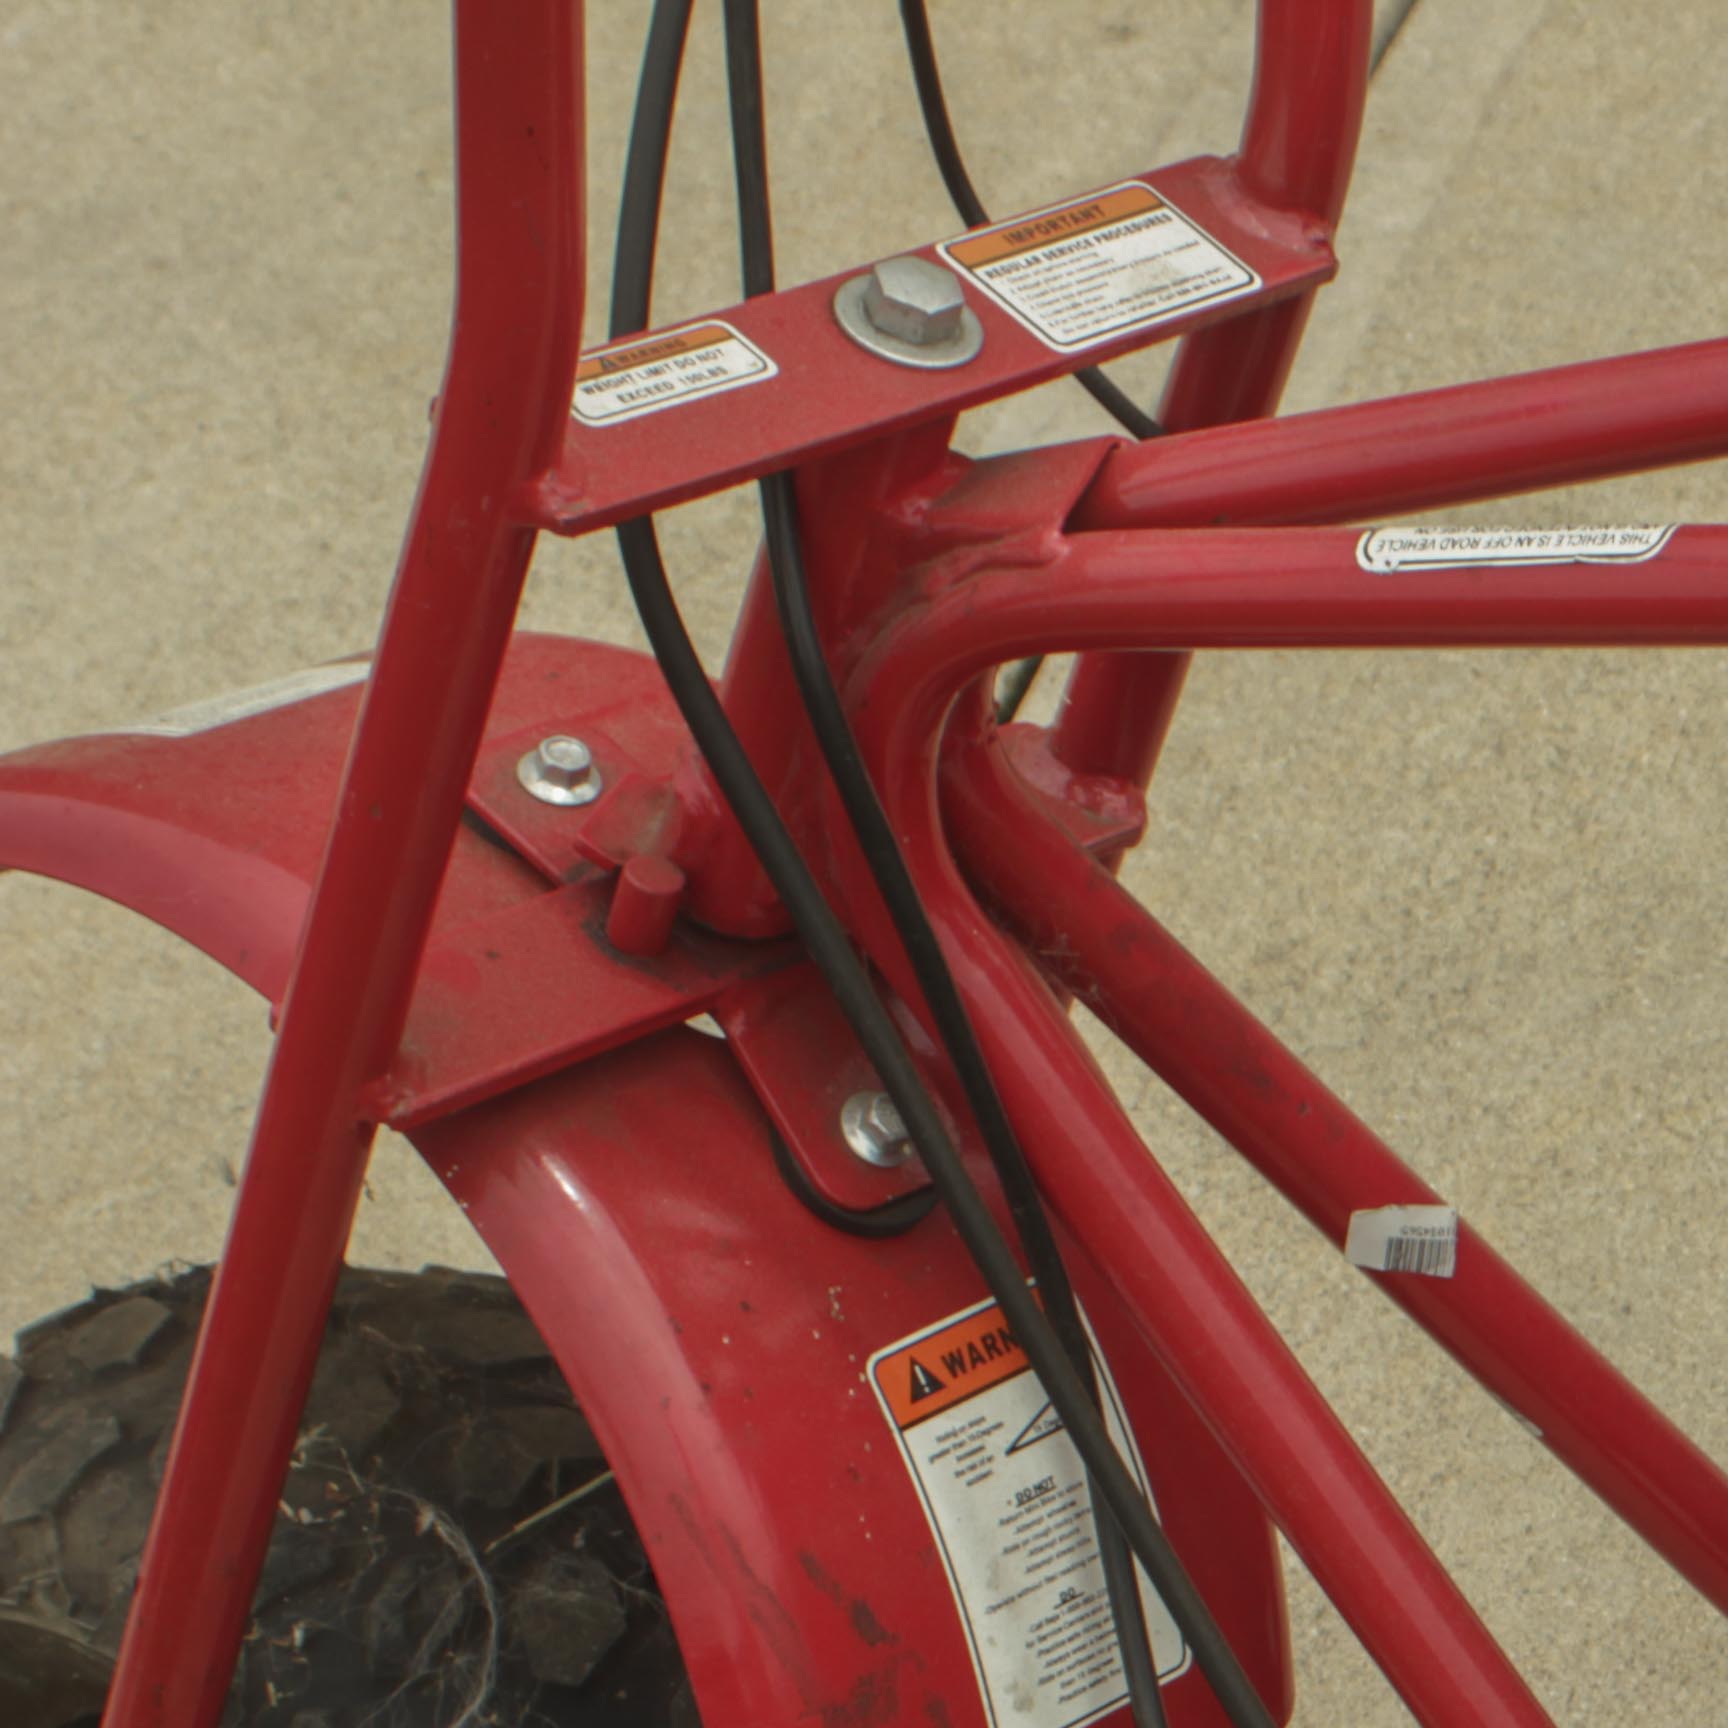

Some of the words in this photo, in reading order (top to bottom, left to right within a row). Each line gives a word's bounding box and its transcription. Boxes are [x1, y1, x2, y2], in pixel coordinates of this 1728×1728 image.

[983, 253, 1040, 279] REGULAR
[1041, 237, 1093, 263] SERVICE
[1095, 211, 1174, 247] PROCEDURES
[1003, 204, 1105, 246] IMPORTANT
[580, 374, 635, 397] WEIGHT
[635, 363, 673, 382] LIMIT
[673, 356, 697, 370] DO
[697, 347, 725, 363] NOT
[616, 380, 676, 404] EXCEED
[940, 1326, 1020, 1379] WARN
[1015, 1486, 1033, 1503] DO
[1033, 1475, 1056, 1497] NOT
